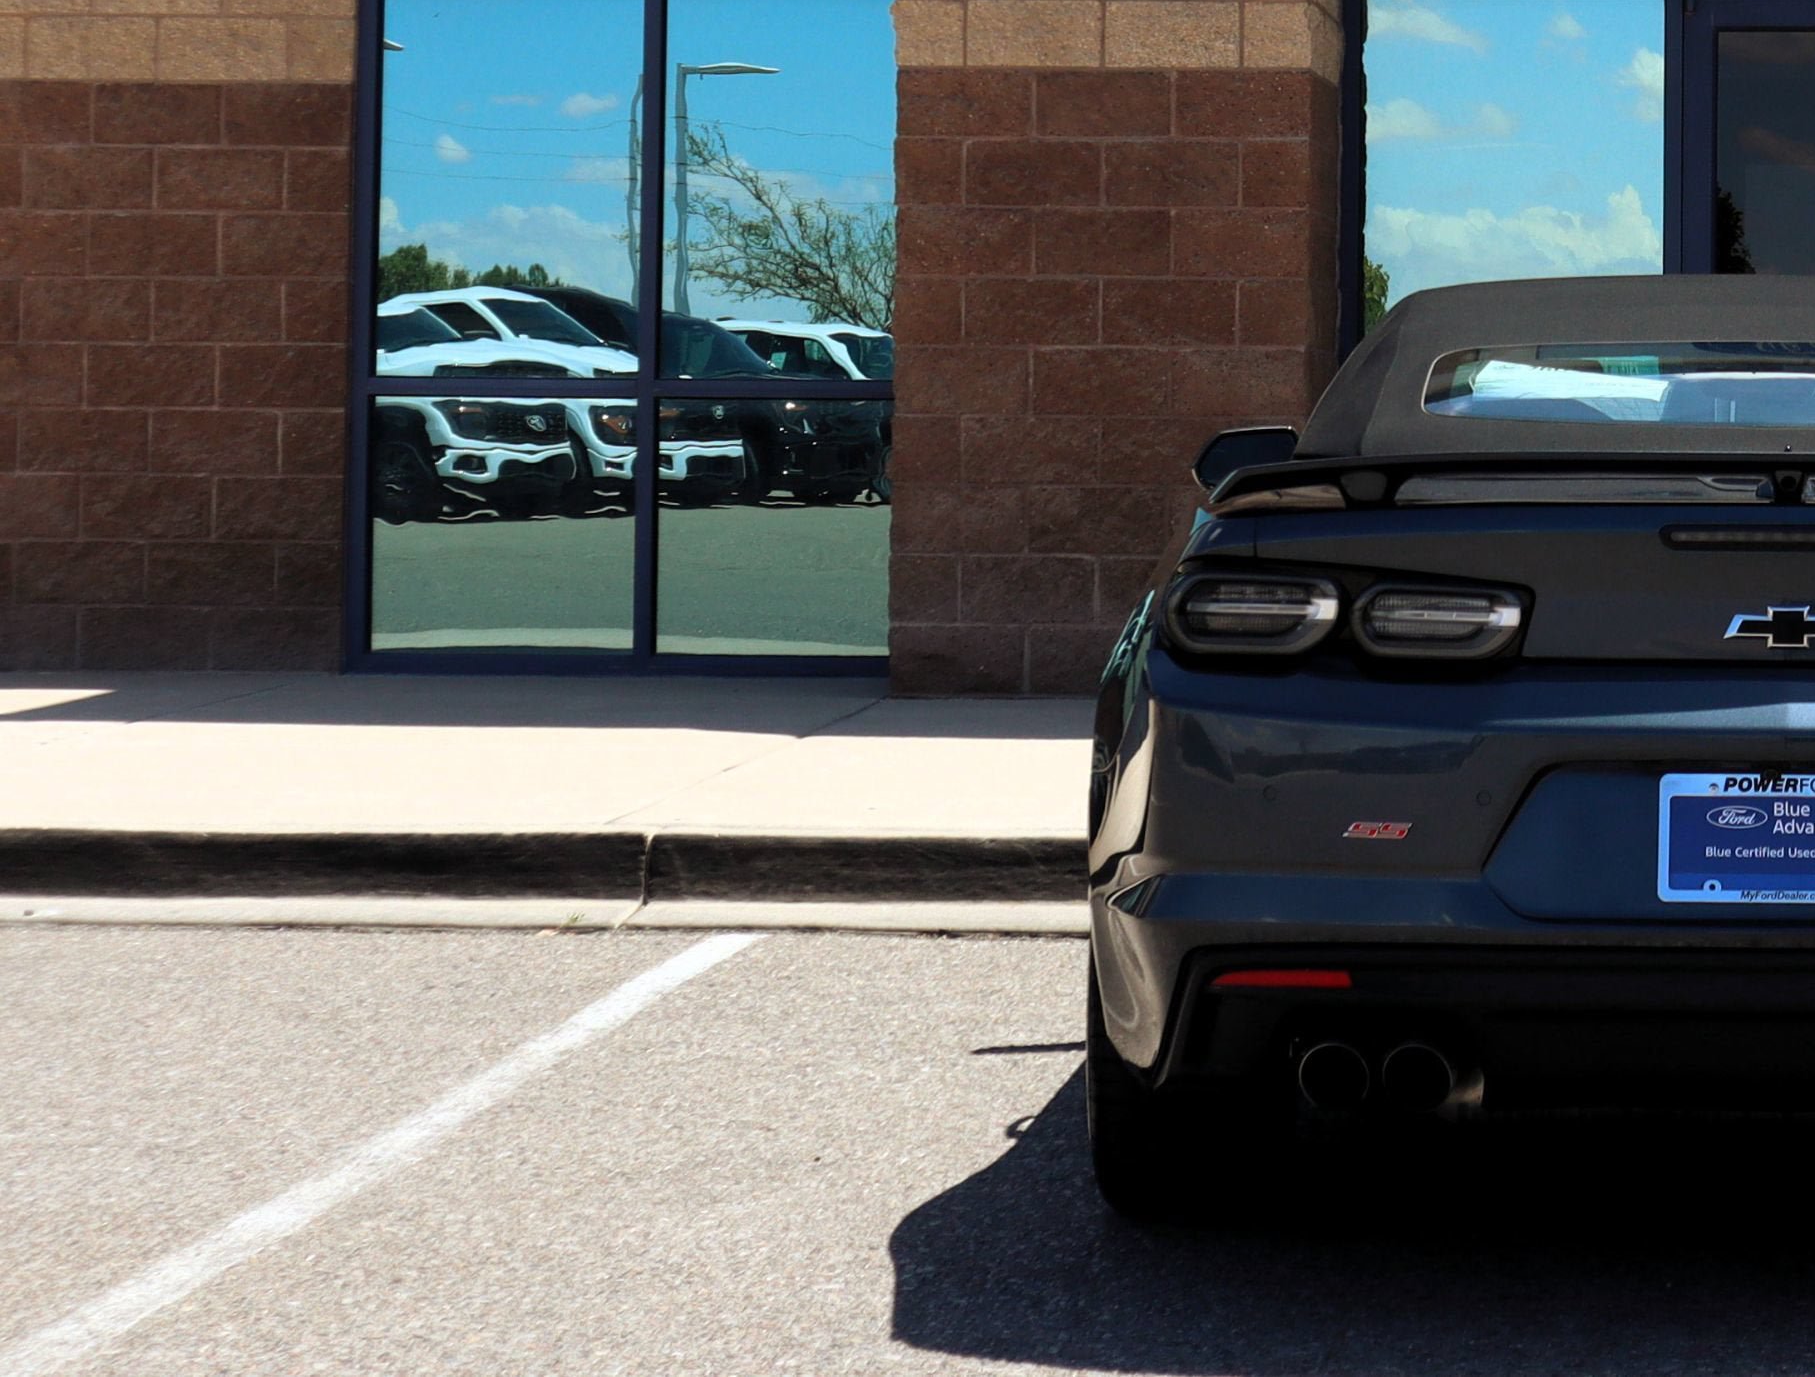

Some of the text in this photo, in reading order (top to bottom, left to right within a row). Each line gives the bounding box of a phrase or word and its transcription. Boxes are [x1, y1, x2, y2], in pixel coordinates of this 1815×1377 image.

[1718, 808, 1756, 825] Ford
[1773, 801, 1811, 817] Blue
[1705, 846, 1732, 858] Blue
[1735, 846, 1784, 858] Certified
